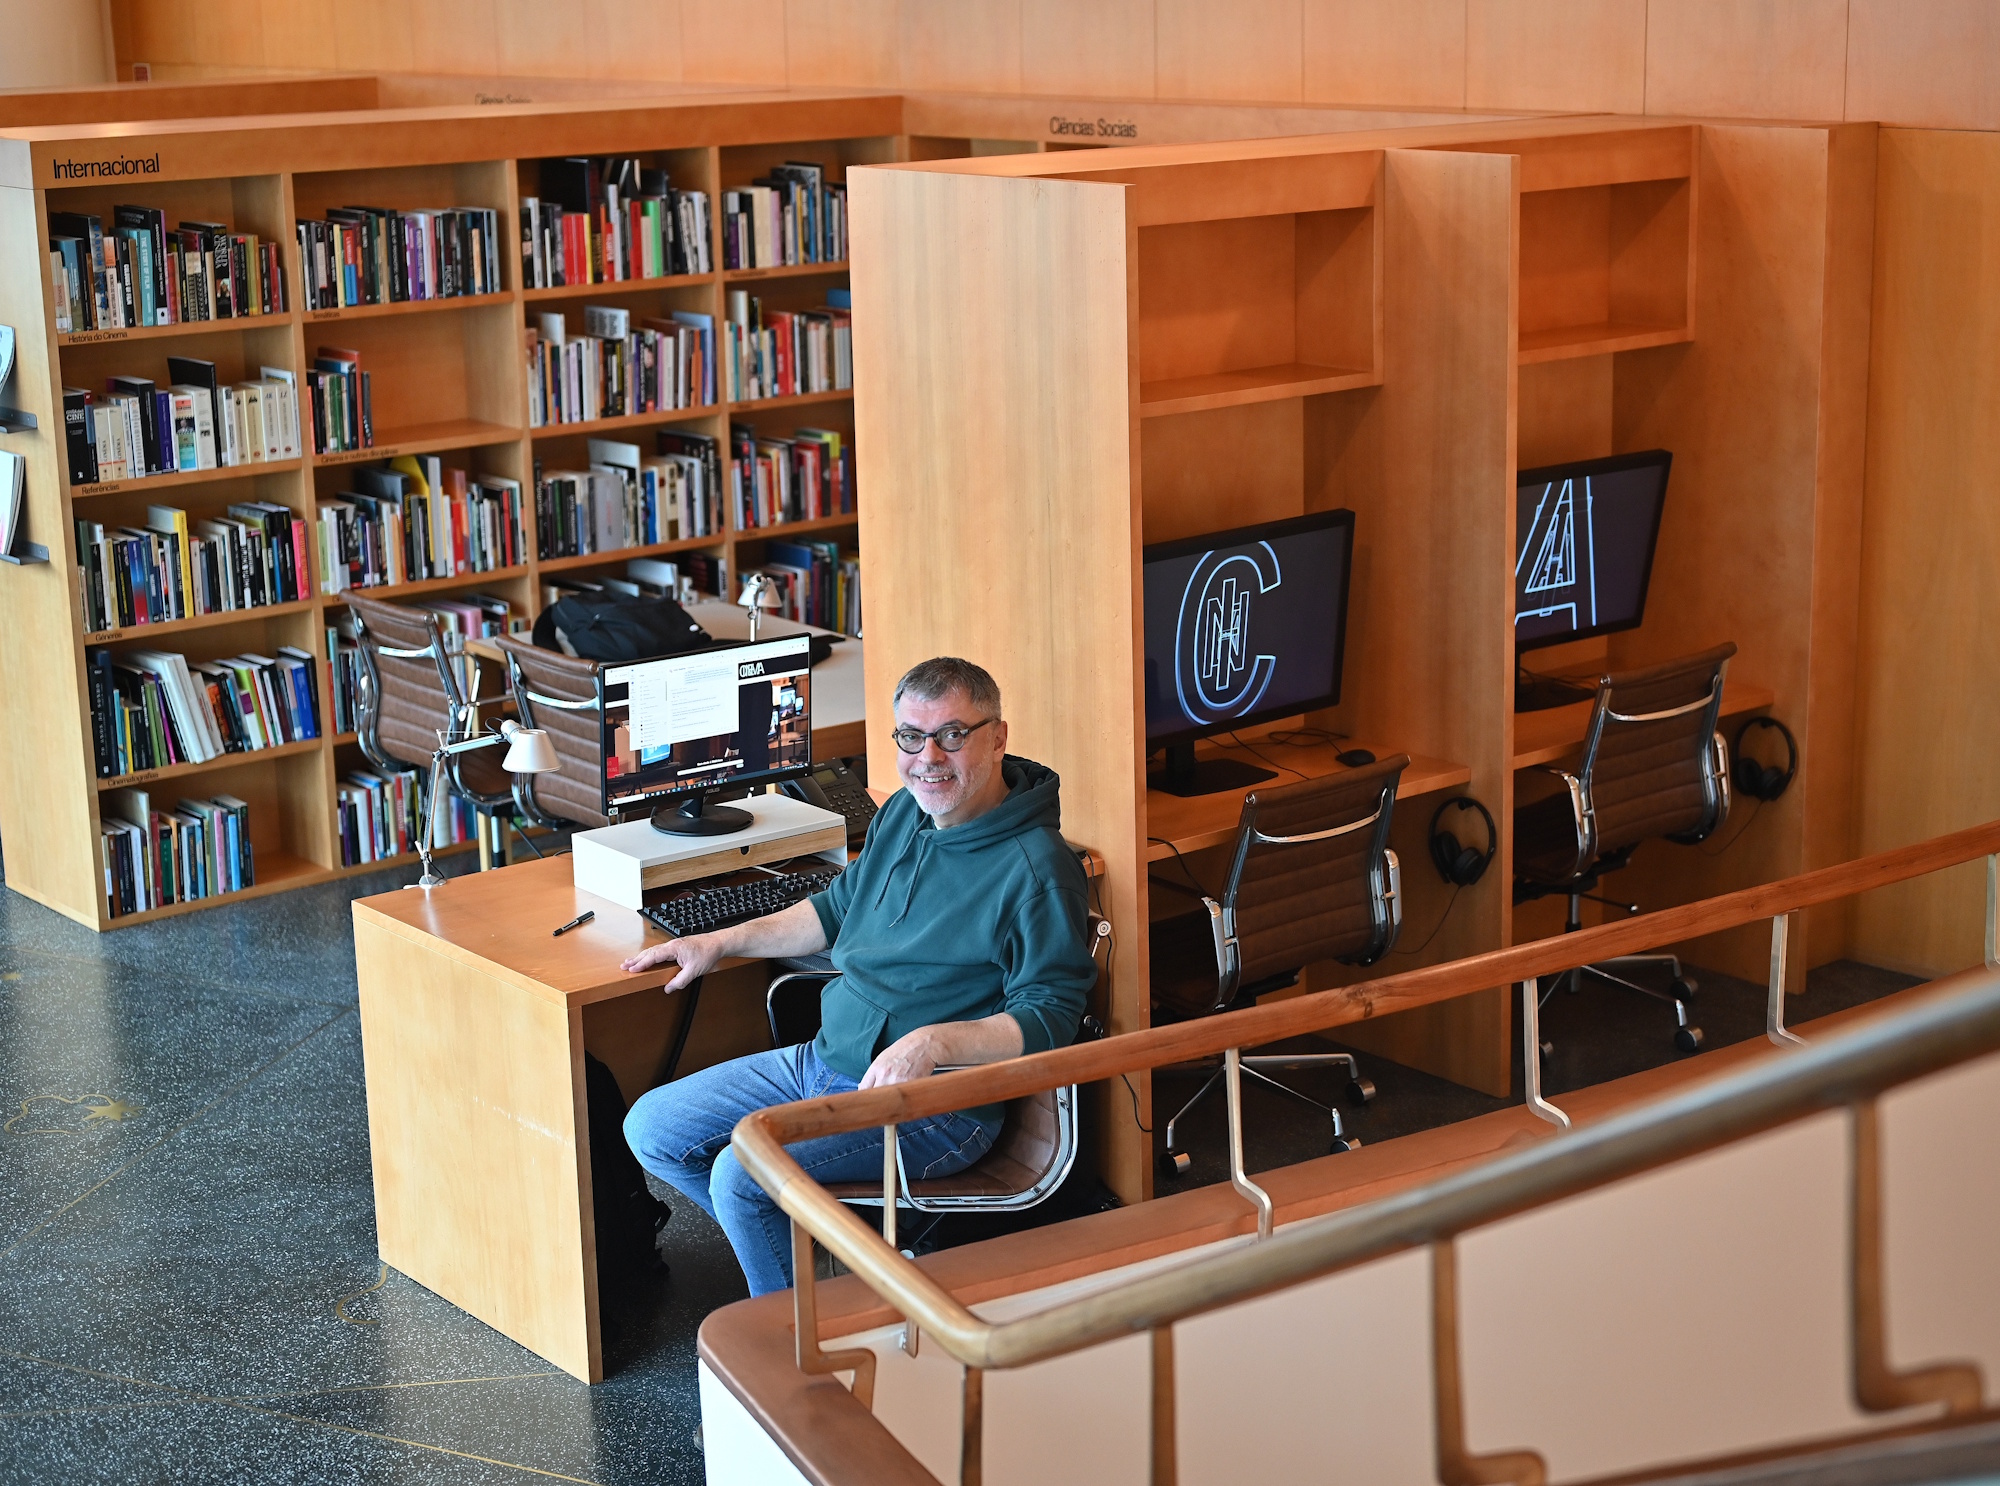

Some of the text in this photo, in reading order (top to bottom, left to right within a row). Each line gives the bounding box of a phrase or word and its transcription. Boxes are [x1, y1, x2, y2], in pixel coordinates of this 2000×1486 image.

[1049, 116, 1137, 137] Ciências Sociais
[53, 153, 159, 179] Internacional
[68, 331, 128, 343] História do Cinema
[81, 484, 120, 495] Referências
[95, 631, 123, 643] Géneros
[107, 771, 159, 787] Cinematografias
